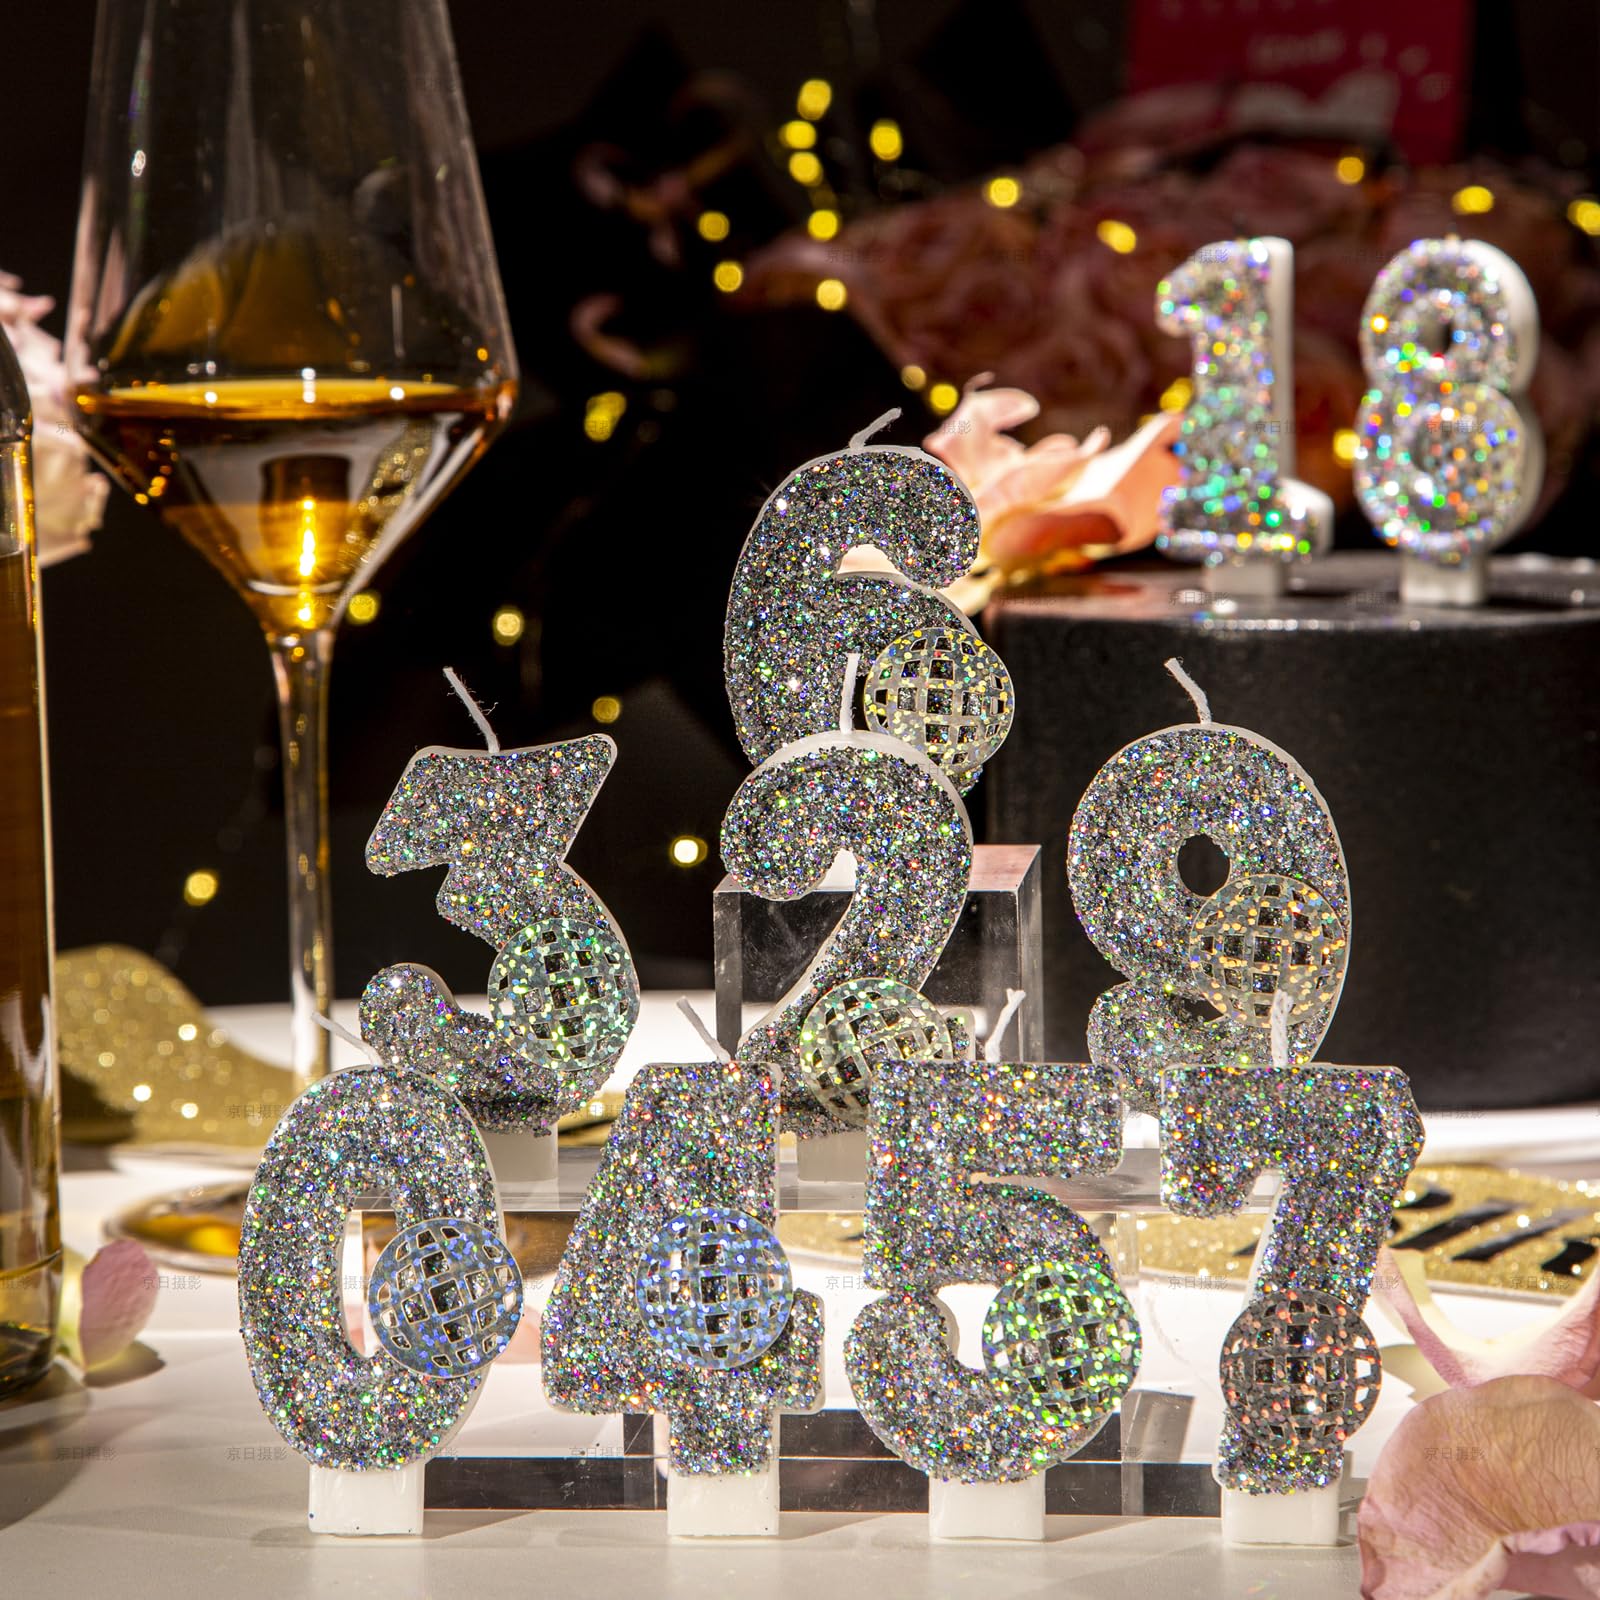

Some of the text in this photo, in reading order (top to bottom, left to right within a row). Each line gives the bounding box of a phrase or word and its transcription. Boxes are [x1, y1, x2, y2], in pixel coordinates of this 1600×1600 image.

[724, 445, 985, 800] 6
[361, 732, 642, 1137] 3
[721, 731, 985, 1138] 2
[1067, 722, 1352, 1116] 9
[239, 1063, 508, 1472] 0
[541, 1062, 825, 1476] 4
[844, 1060, 1138, 1483] 5
[1160, 1064, 1424, 1493] 7
